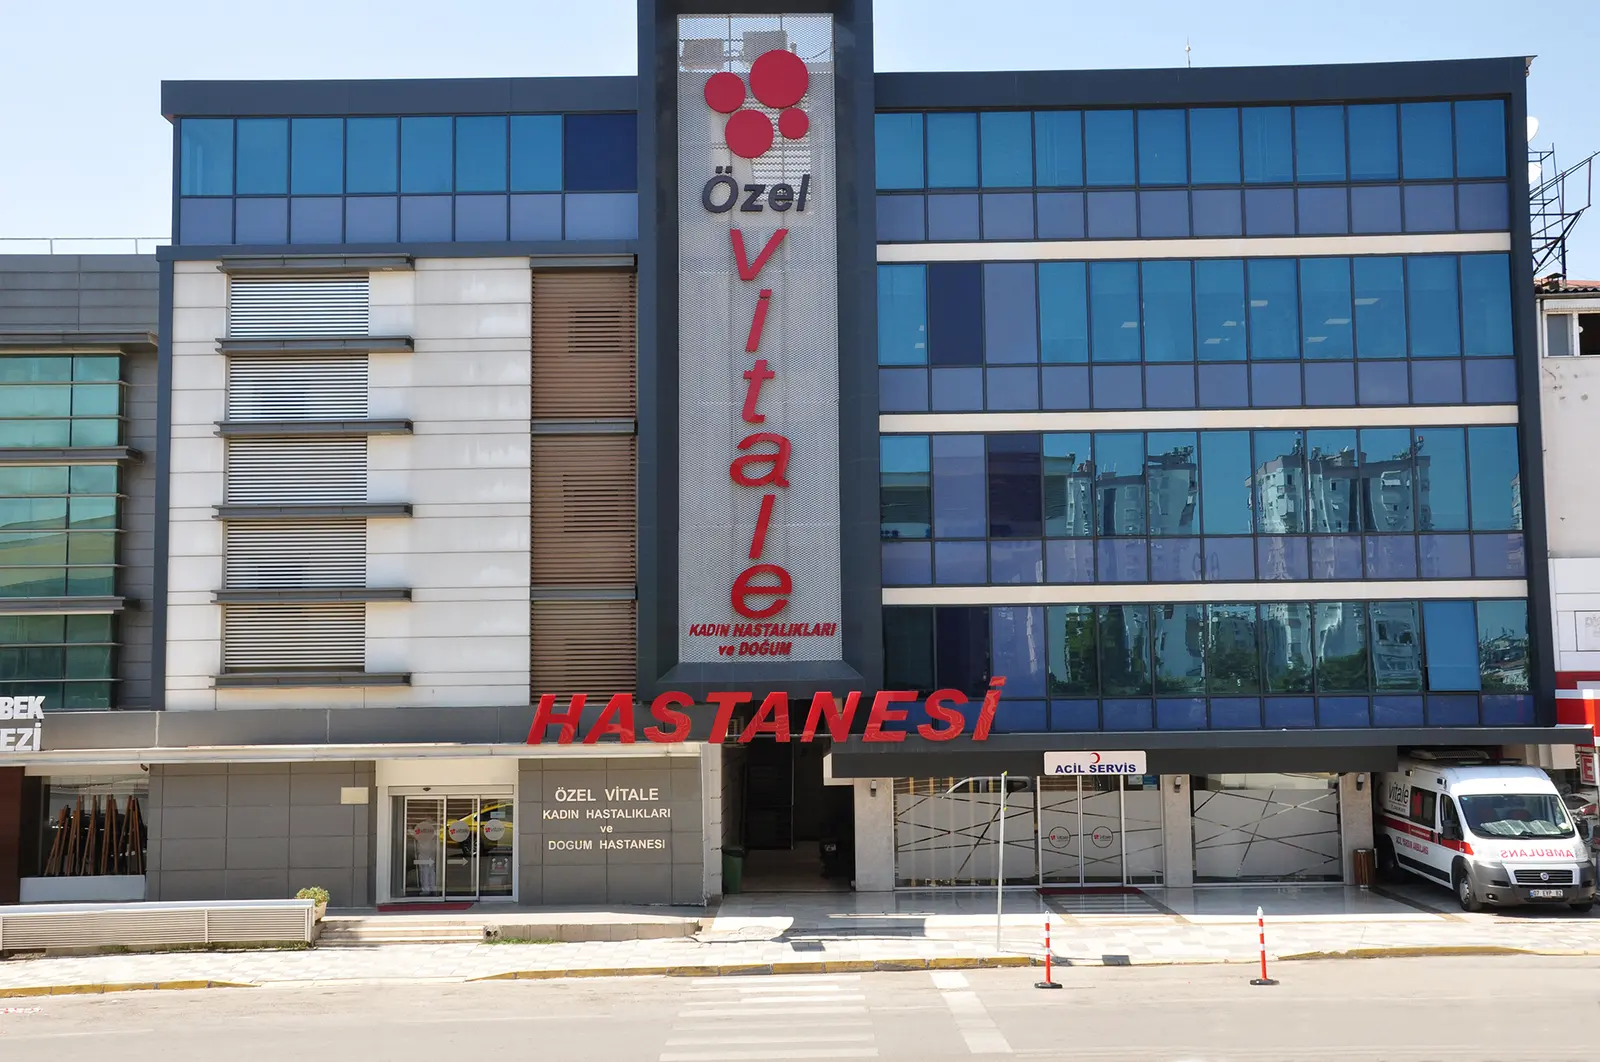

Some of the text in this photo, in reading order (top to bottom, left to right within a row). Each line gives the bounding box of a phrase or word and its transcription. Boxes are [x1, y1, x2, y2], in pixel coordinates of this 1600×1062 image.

[702, 166, 811, 213] Özel
[689, 623, 837, 637] KADIN HASTALIKLARI
[718, 640, 793, 656] ve DOĞUM
[527, 676, 1007, 744] HASTANESİ
[1055, 762, 1137, 773] ACİL SERVİS
[555, 786, 659, 802] ÖZEL VİTALE
[542, 808, 671, 819] KADIN HASTALIKLARI
[600, 825, 613, 833] ve
